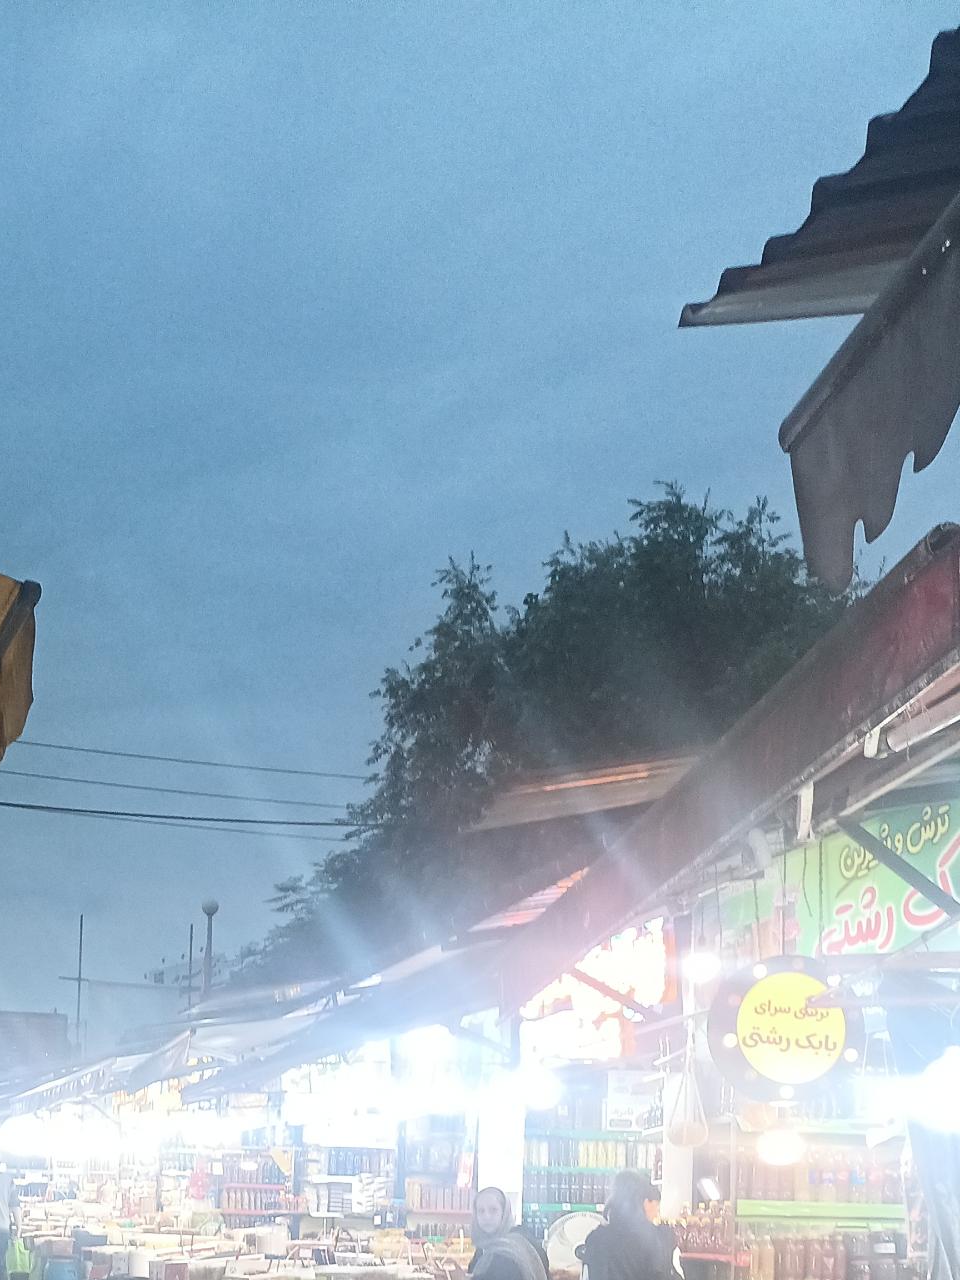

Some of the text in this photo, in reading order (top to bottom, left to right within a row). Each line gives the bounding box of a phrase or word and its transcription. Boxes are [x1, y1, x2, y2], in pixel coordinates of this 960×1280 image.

[906, 804, 949, 854] ترش
[894, 832, 904, 855] و
[754, 999, 791, 1017] سرای
[742, 1026, 838, 1056] بابک رشتی
